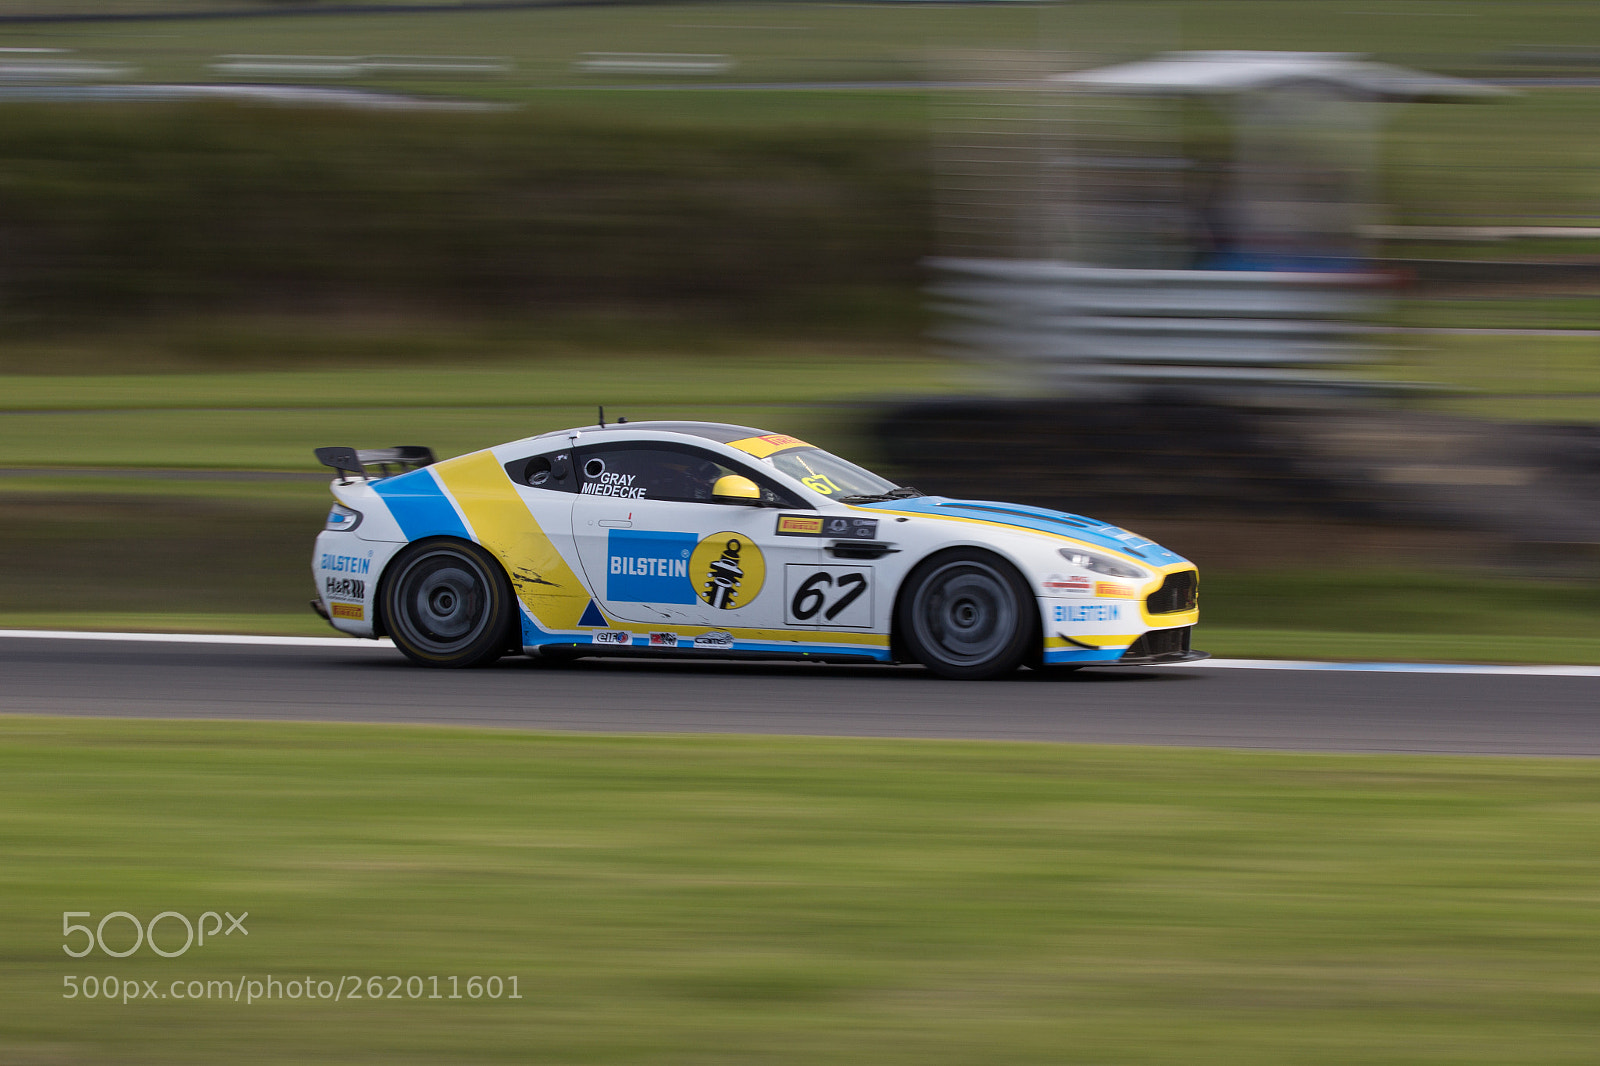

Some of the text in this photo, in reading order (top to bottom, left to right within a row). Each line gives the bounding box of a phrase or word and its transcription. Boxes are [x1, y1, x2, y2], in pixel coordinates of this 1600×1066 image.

[601, 472, 636, 486] GRAY
[801, 474, 842, 495] 67
[581, 482, 647, 500] MIEDECKE
[321, 553, 370, 574] BILSTEIN
[610, 556, 686, 577] BILSTEIN
[792, 571, 867, 621] 67
[1053, 605, 1121, 622] BILSTEIN
[597, 632, 618, 642] elf
